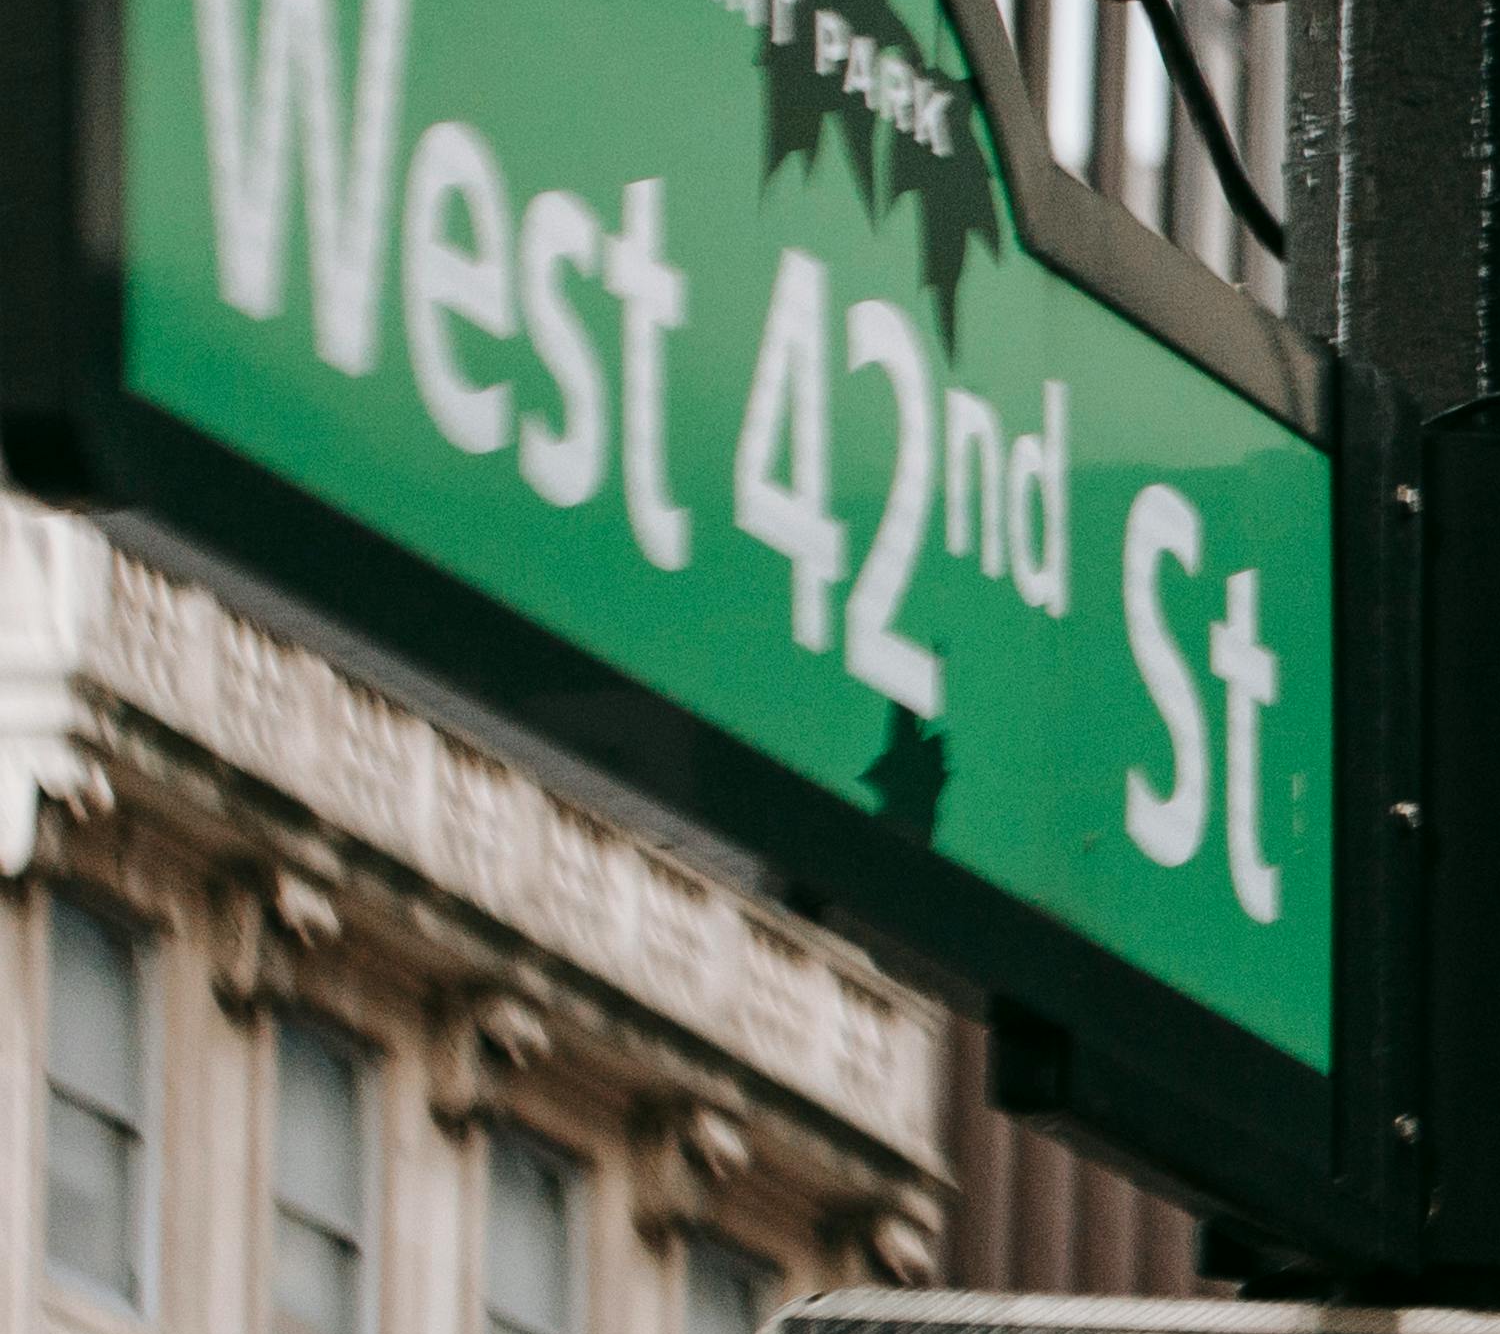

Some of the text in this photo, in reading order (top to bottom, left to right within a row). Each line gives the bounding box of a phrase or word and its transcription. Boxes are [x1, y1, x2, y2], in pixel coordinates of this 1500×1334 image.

[813, 10, 954, 158] PARK
[733, 247, 1070, 720] 42nd
[1122, 483, 1280, 923] St
